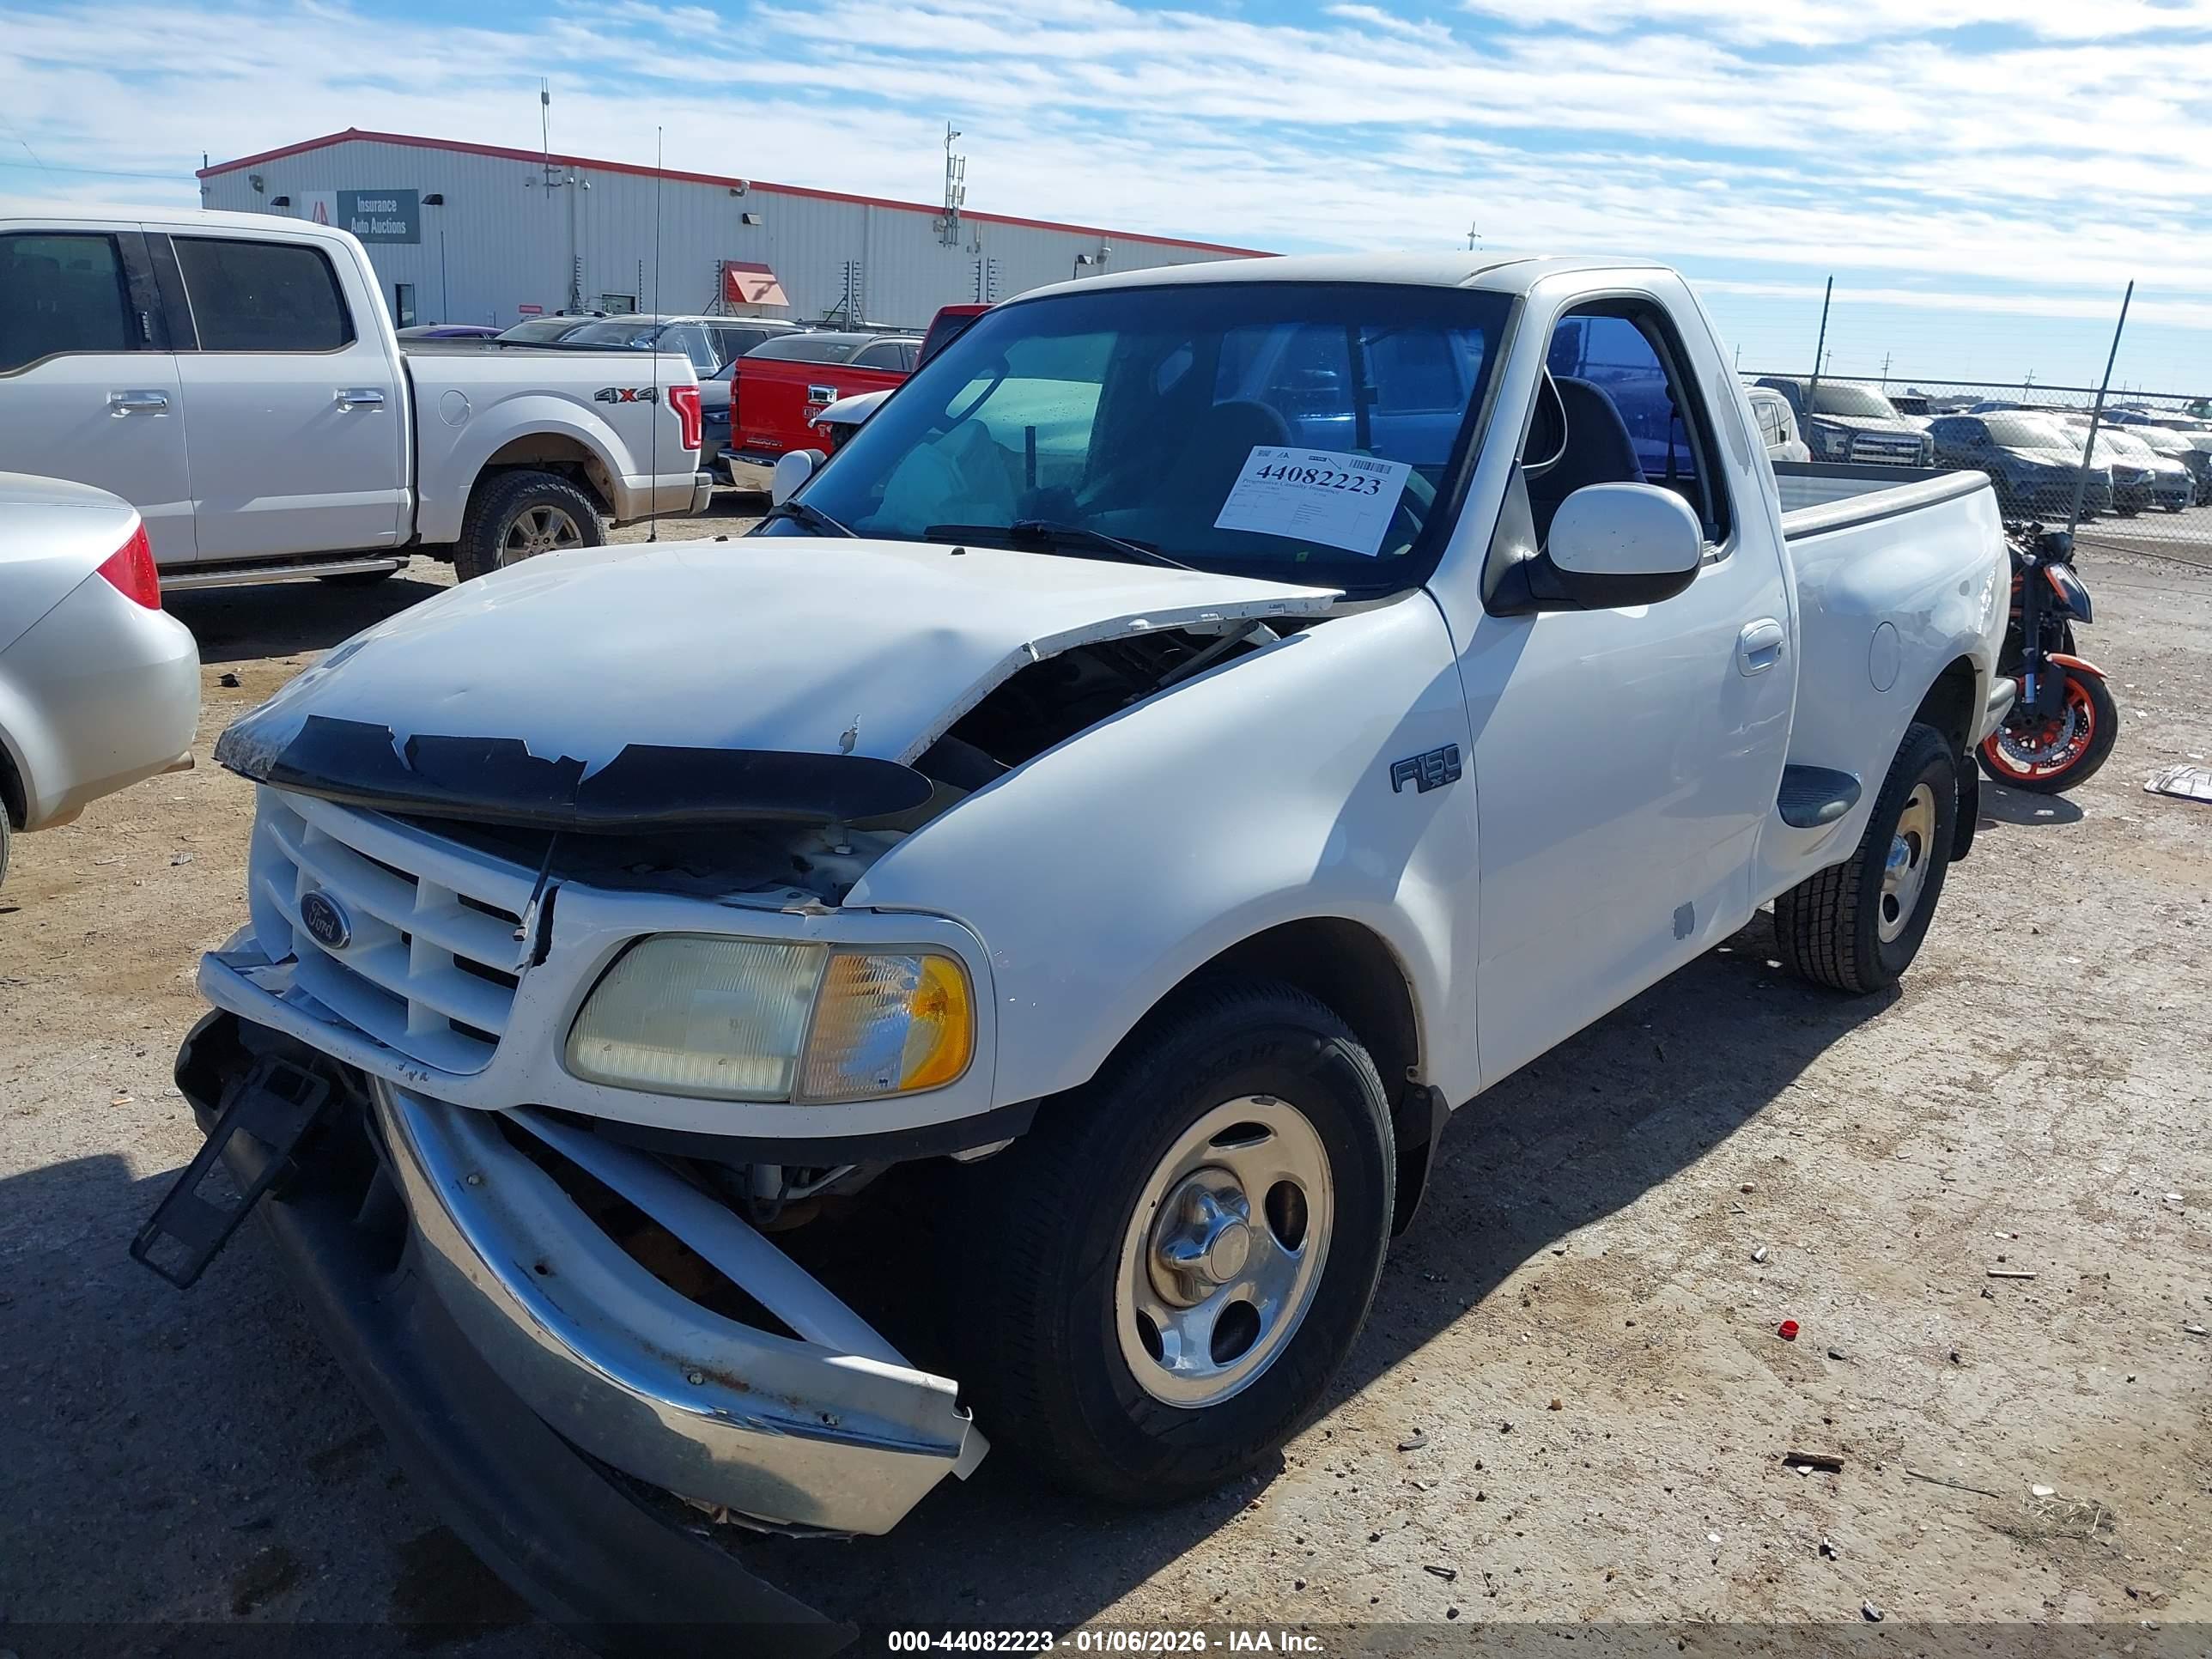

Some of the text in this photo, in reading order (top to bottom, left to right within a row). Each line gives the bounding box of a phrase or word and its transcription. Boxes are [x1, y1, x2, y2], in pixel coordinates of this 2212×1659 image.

[357, 196, 398, 213] Insurance
[351, 216, 406, 234] Auto Auctions
[749, 280, 778, 301] 7
[1256, 464, 1381, 495] 44082223
[310, 901, 335, 939] Ford
